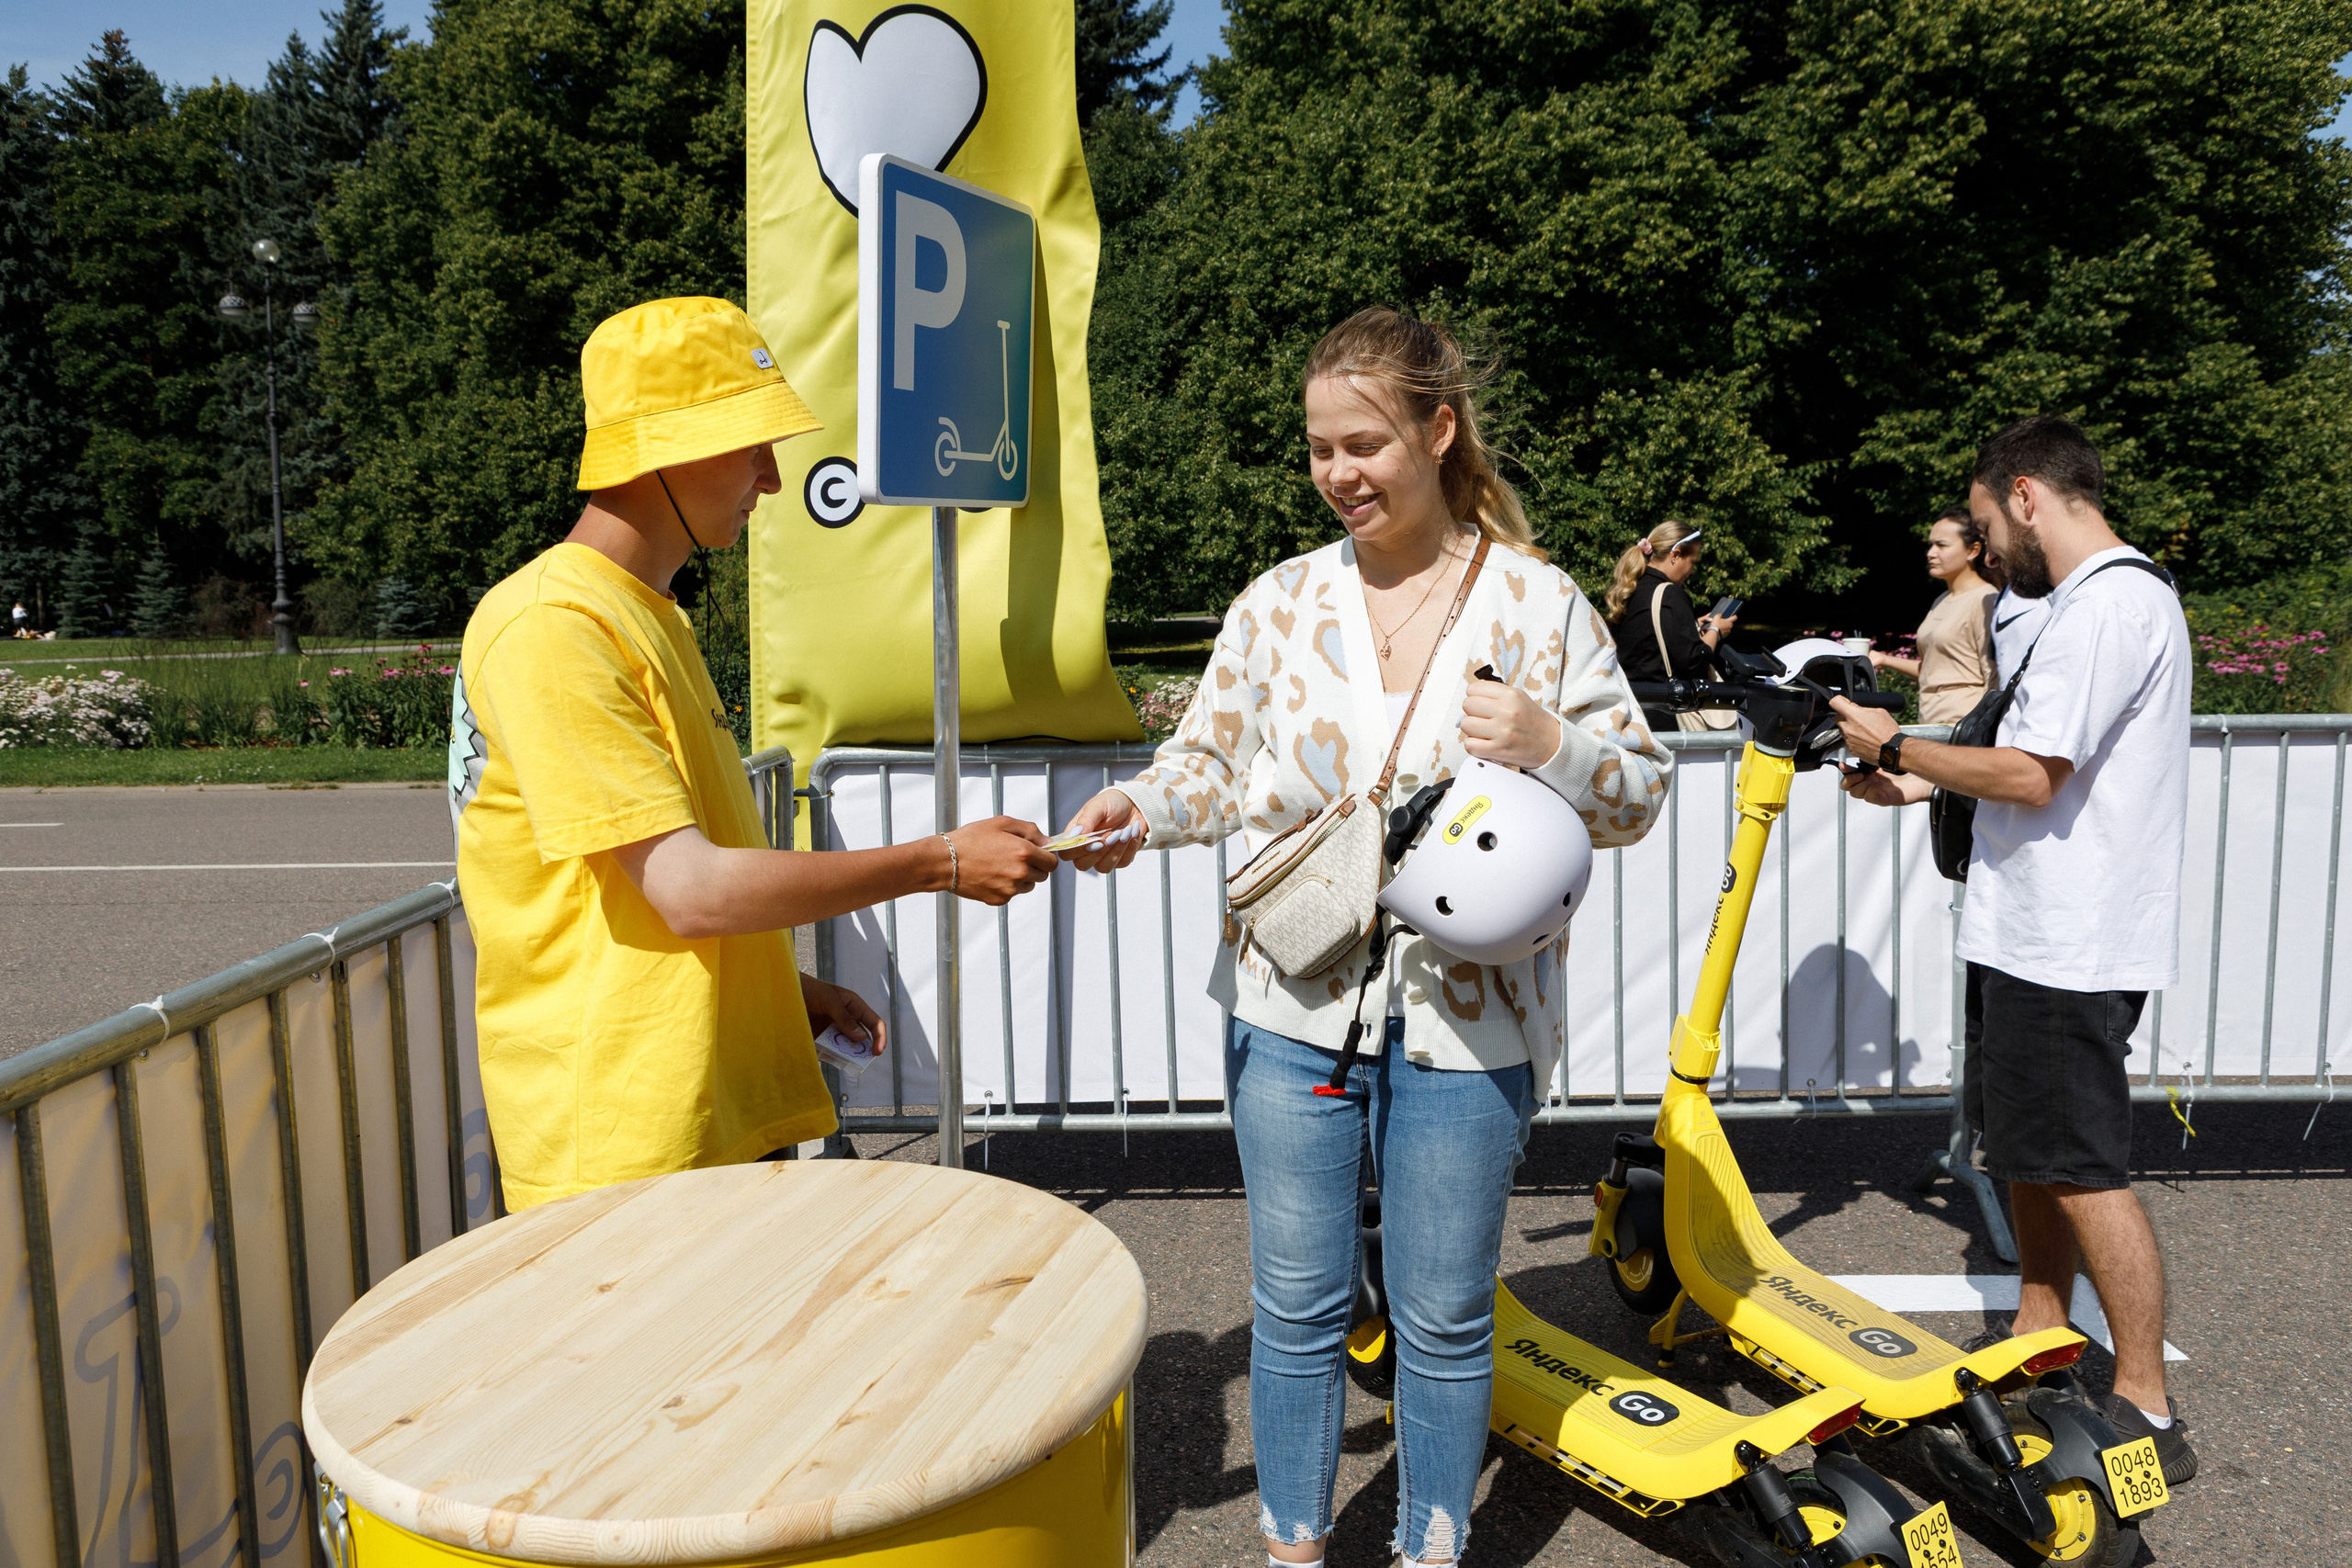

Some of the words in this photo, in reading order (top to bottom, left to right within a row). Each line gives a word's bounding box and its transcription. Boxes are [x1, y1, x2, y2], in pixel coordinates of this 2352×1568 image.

[893, 189, 967, 391] P
[1459, 801, 1484, 824] Яндекс
[1759, 1276, 1858, 1329] Яндекс
[1859, 1330, 1902, 1354] Go
[1504, 1338, 1615, 1396] Яндекс
[1619, 1394, 1665, 1421] Go
[2111, 1447, 2155, 1476] 0048
[2120, 1477, 2163, 1507] 1893
[1910, 1512, 1948, 1551] 0049
[1920, 1545, 1957, 1568] 554
